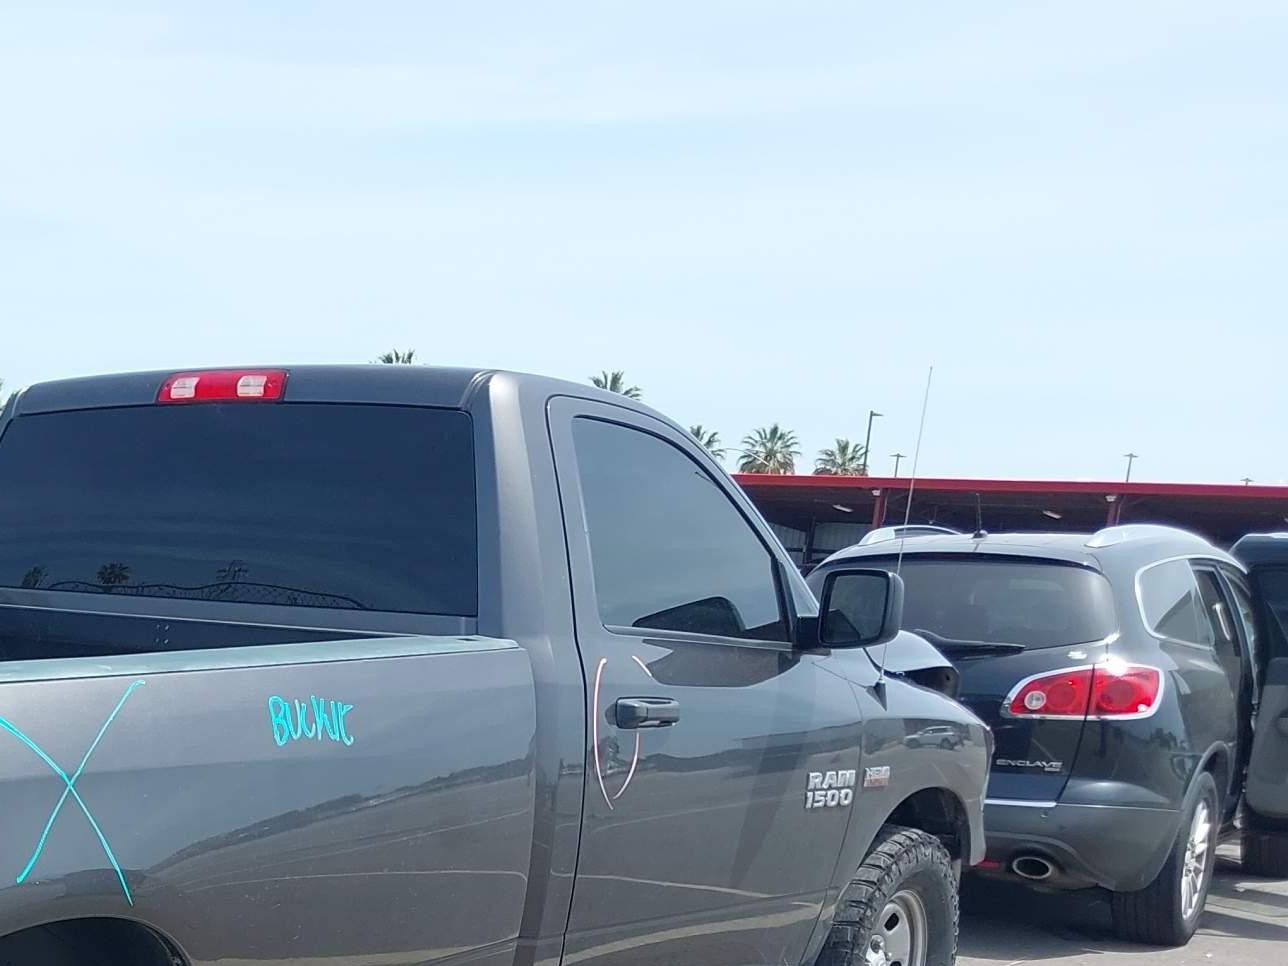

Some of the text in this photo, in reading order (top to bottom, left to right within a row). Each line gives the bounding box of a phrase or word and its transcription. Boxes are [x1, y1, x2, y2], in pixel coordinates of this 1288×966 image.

[996, 758, 1064, 769] ENCLAVE
[807, 769, 857, 791] RAM
[805, 787, 854, 809] 1500
